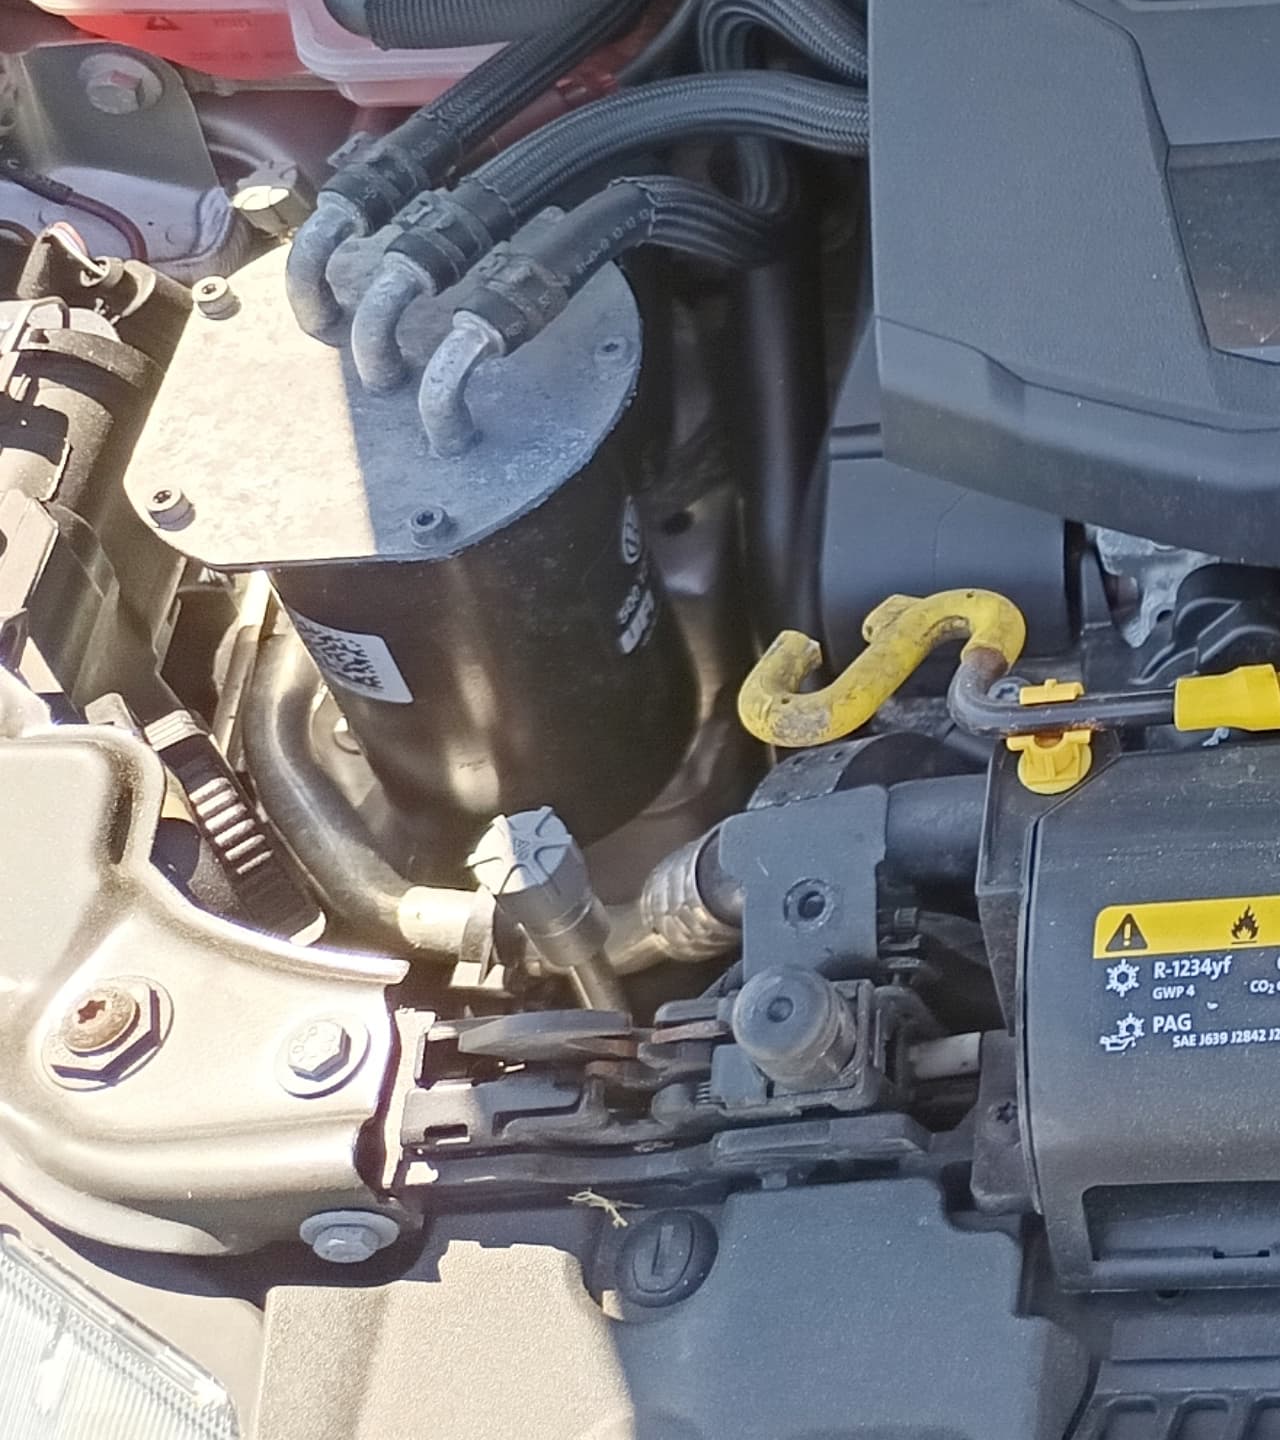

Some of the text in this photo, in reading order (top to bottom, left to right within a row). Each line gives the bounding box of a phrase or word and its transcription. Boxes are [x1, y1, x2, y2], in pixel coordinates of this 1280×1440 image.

[1153, 955, 1233, 980] R-1234yf
[1152, 986, 1184, 1000] GWP
[1185, 984, 1196, 997] 4
[1153, 1013, 1192, 1034] PAG
[1172, 1033, 1197, 1048] SAE
[1199, 1031, 1229, 1046] J639
[1230, 1029, 1267, 1045] J2842
